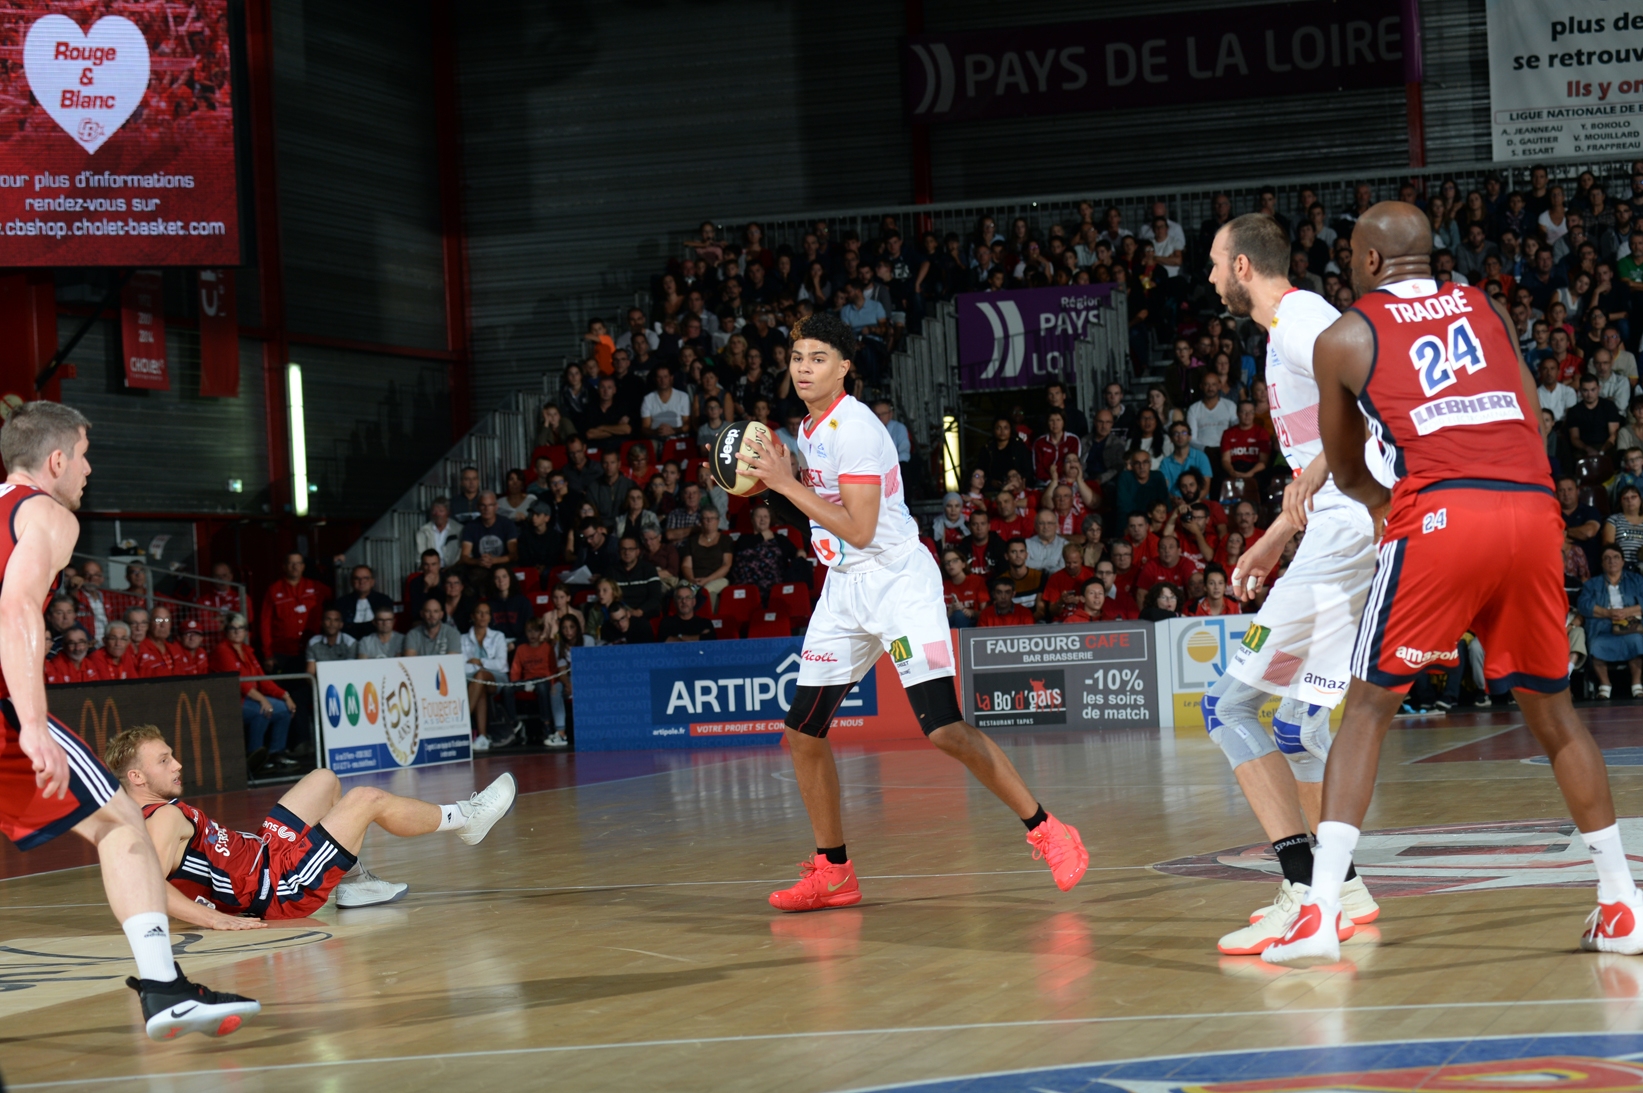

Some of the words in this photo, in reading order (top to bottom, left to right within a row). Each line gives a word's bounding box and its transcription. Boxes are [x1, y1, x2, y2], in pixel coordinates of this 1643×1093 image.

[1551, 16, 1606, 42] plus
[54, 41, 117, 66] Rouge
[963, 46, 1089, 98] PAYS
[1104, 39, 1169, 88] DE
[1186, 32, 1249, 80] LA
[1265, 15, 1404, 74] LOIRE
[1513, 54, 1541, 71] se
[79, 67, 94, 86] &
[60, 89, 116, 110] Blanc
[1567, 80, 1593, 98] Ils
[1598, 80, 1613, 101] y
[1509, 110, 1544, 122] LIGUE
[1546, 105, 1617, 119] NATIONALE
[1620, 104, 1636, 114] DE
[1514, 125, 1564, 136] JEANNEAU
[1519, 136, 1559, 146] GAUTIER
[1584, 131, 1640, 142] MOUILLARD
[34, 170, 70, 192] plus
[75, 170, 195, 188] d'informations
[25, 195, 127, 212] rendez-vous
[132, 198, 161, 212] sur
[0, 217, 226, 240] .cbshop.cholet-basket.com
[1384, 288, 1474, 323] TRAORÉ
[1039, 309, 1099, 337] PAYS
[1408, 316, 1488, 398] 24
[1413, 394, 1518, 426] LIEBHERR
[719, 428, 741, 465] Jeep
[1422, 507, 1447, 535] 24
[986, 635, 1080, 655] FAUBOURG
[1084, 633, 1130, 649] CAFE
[1023, 653, 1041, 663] BAR
[1043, 651, 1093, 662] BRASSERIE
[666, 652, 863, 716] ARTIPÔE
[1084, 668, 1144, 691] -10%
[386, 681, 412, 729] 50
[1083, 691, 1104, 705] les
[1108, 692, 1145, 705] soirs
[979, 719, 1015, 728] RESTAURANT
[1016, 717, 1034, 726] TAPAS
[1082, 707, 1100, 720] de
[1104, 706, 1150, 720] match
[652, 726, 686, 738] artipole.fr
[696, 723, 724, 734] VOTRE
[725, 721, 754, 733] PROJET
[755, 721, 766, 731] SE
[840, 718, 864, 728] NOUS
[1274, 836, 1308, 853] SPALD
